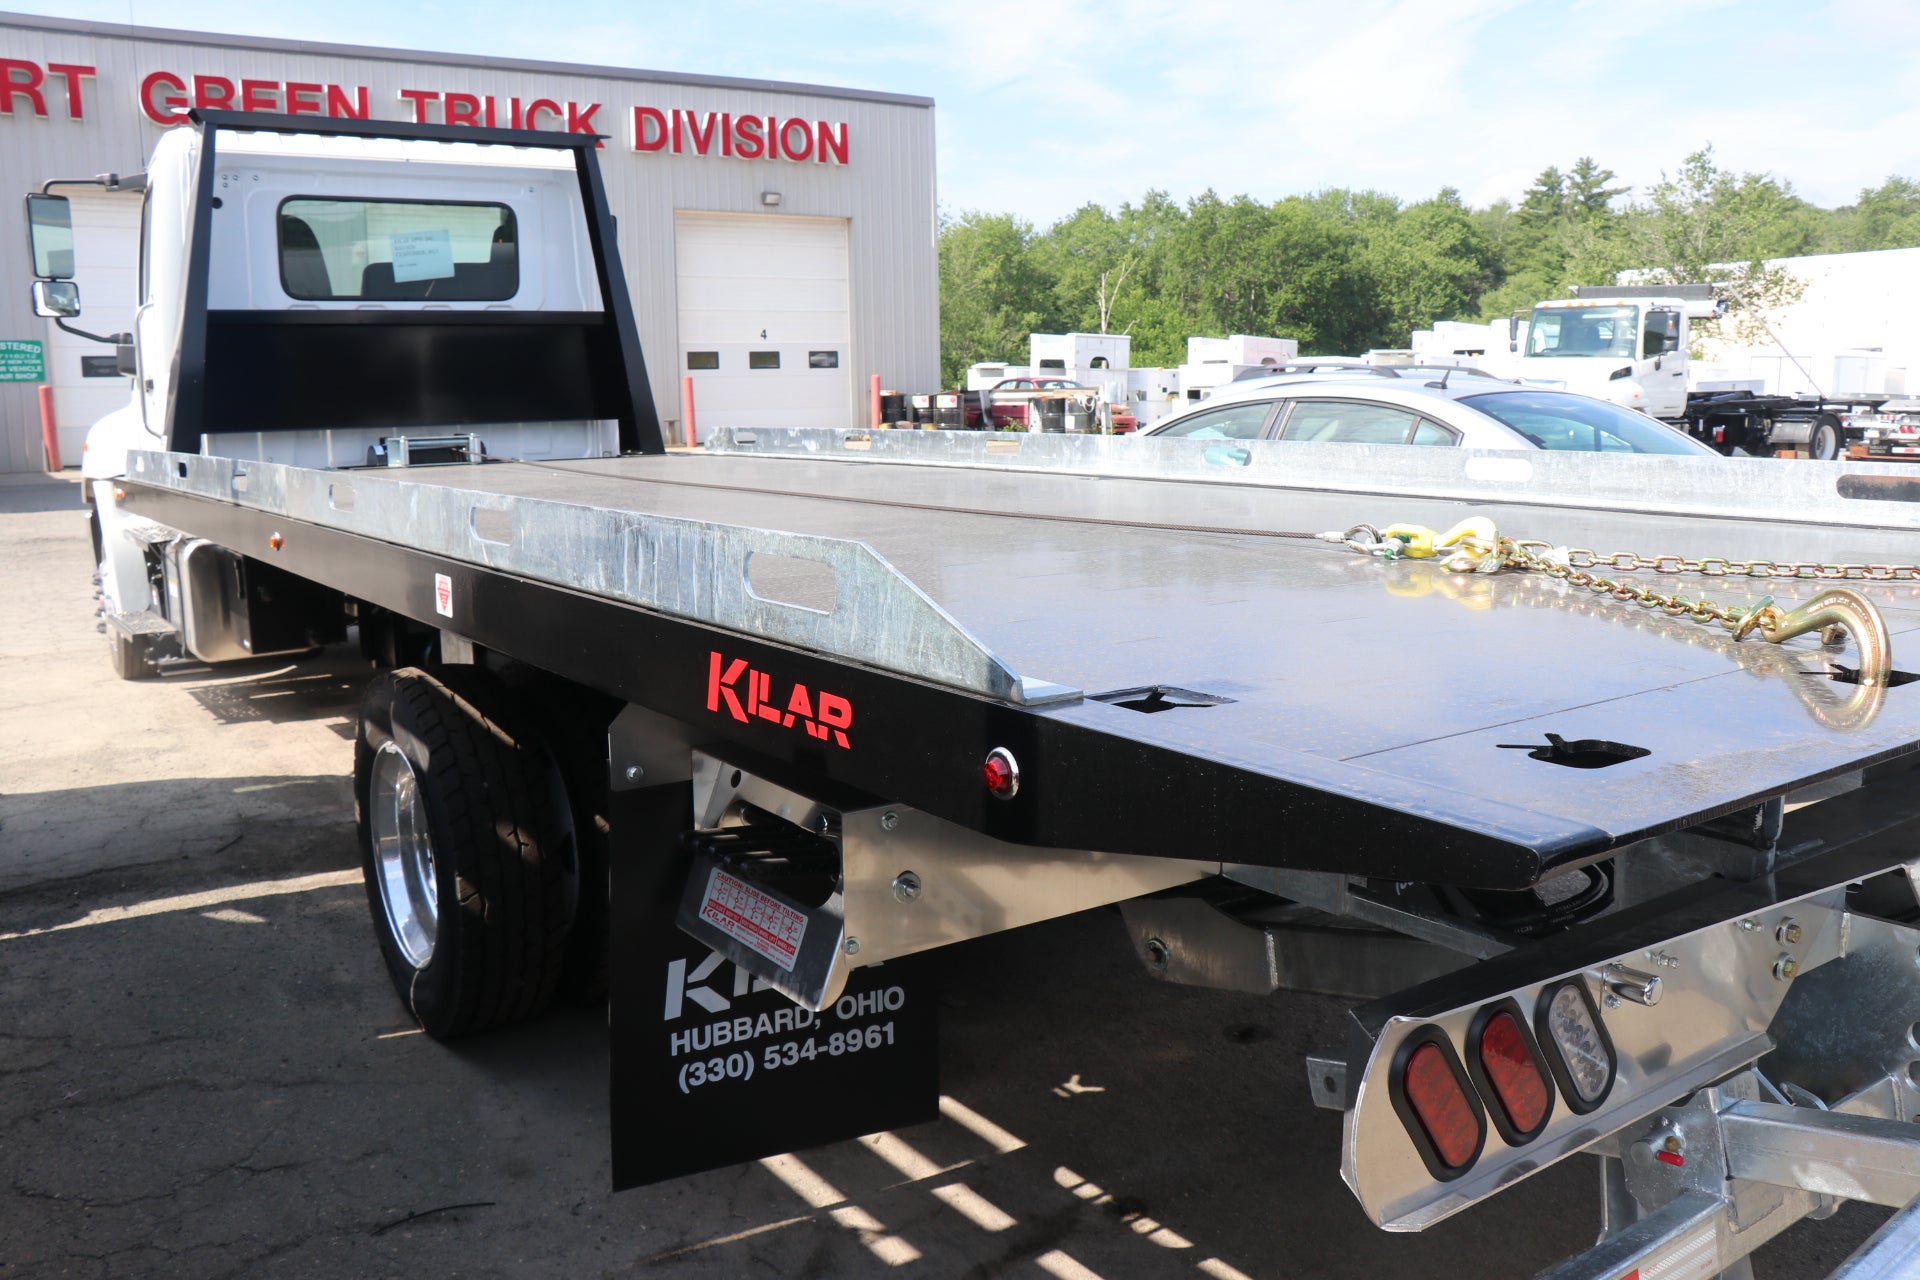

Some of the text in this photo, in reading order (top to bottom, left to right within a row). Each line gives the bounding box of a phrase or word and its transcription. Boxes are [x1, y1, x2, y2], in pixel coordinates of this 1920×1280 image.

[0, 58, 849, 164] RT GREEN TRUCK DIVISION
[760, 329, 767, 340] 4
[707, 651, 853, 749] KILAR
[702, 906, 735, 929] KILAR
[717, 872, 803, 922] CAUTION: SLIDE BEFORE TILTING
[671, 986, 905, 1056] HUBBARD, OHIO
[678, 1021, 895, 1094] (330) 534-8961
